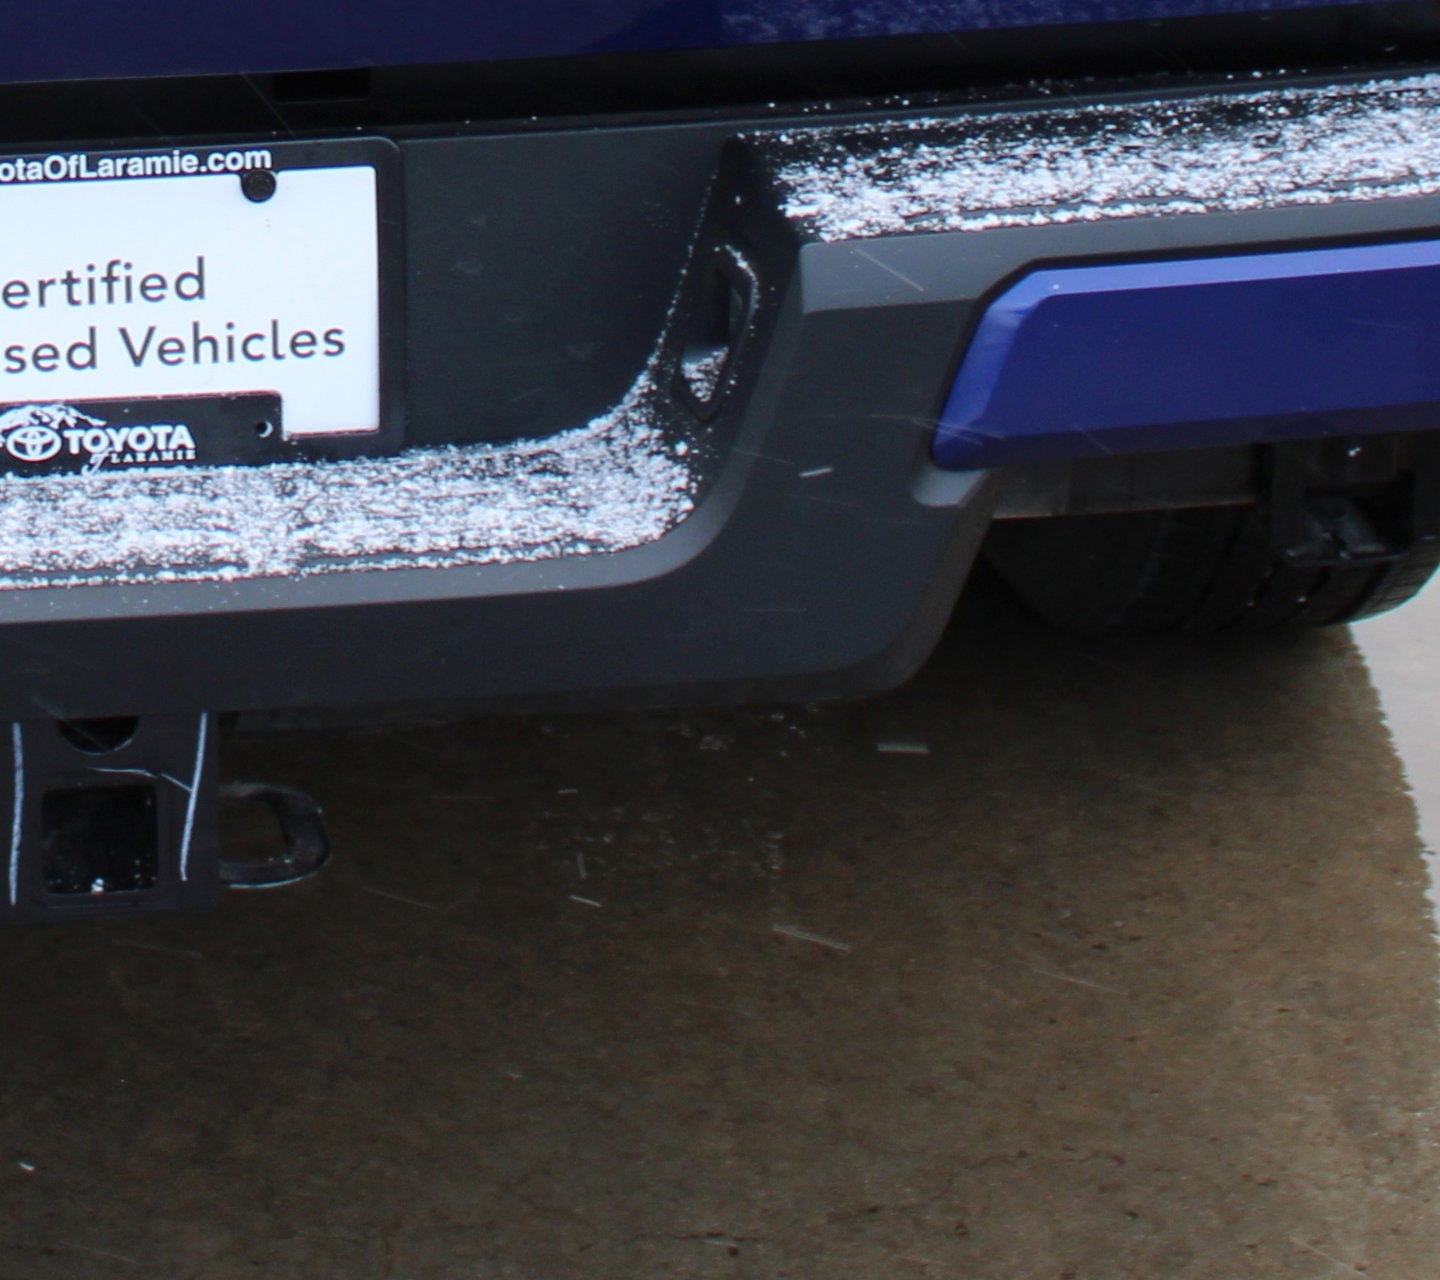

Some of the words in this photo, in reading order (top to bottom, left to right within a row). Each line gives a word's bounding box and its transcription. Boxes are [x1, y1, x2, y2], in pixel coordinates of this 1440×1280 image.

[118, 316, 346, 368] Vehicles
[63, 424, 196, 455] TOYOTA
[110, 449, 196, 464] LARAMIE
